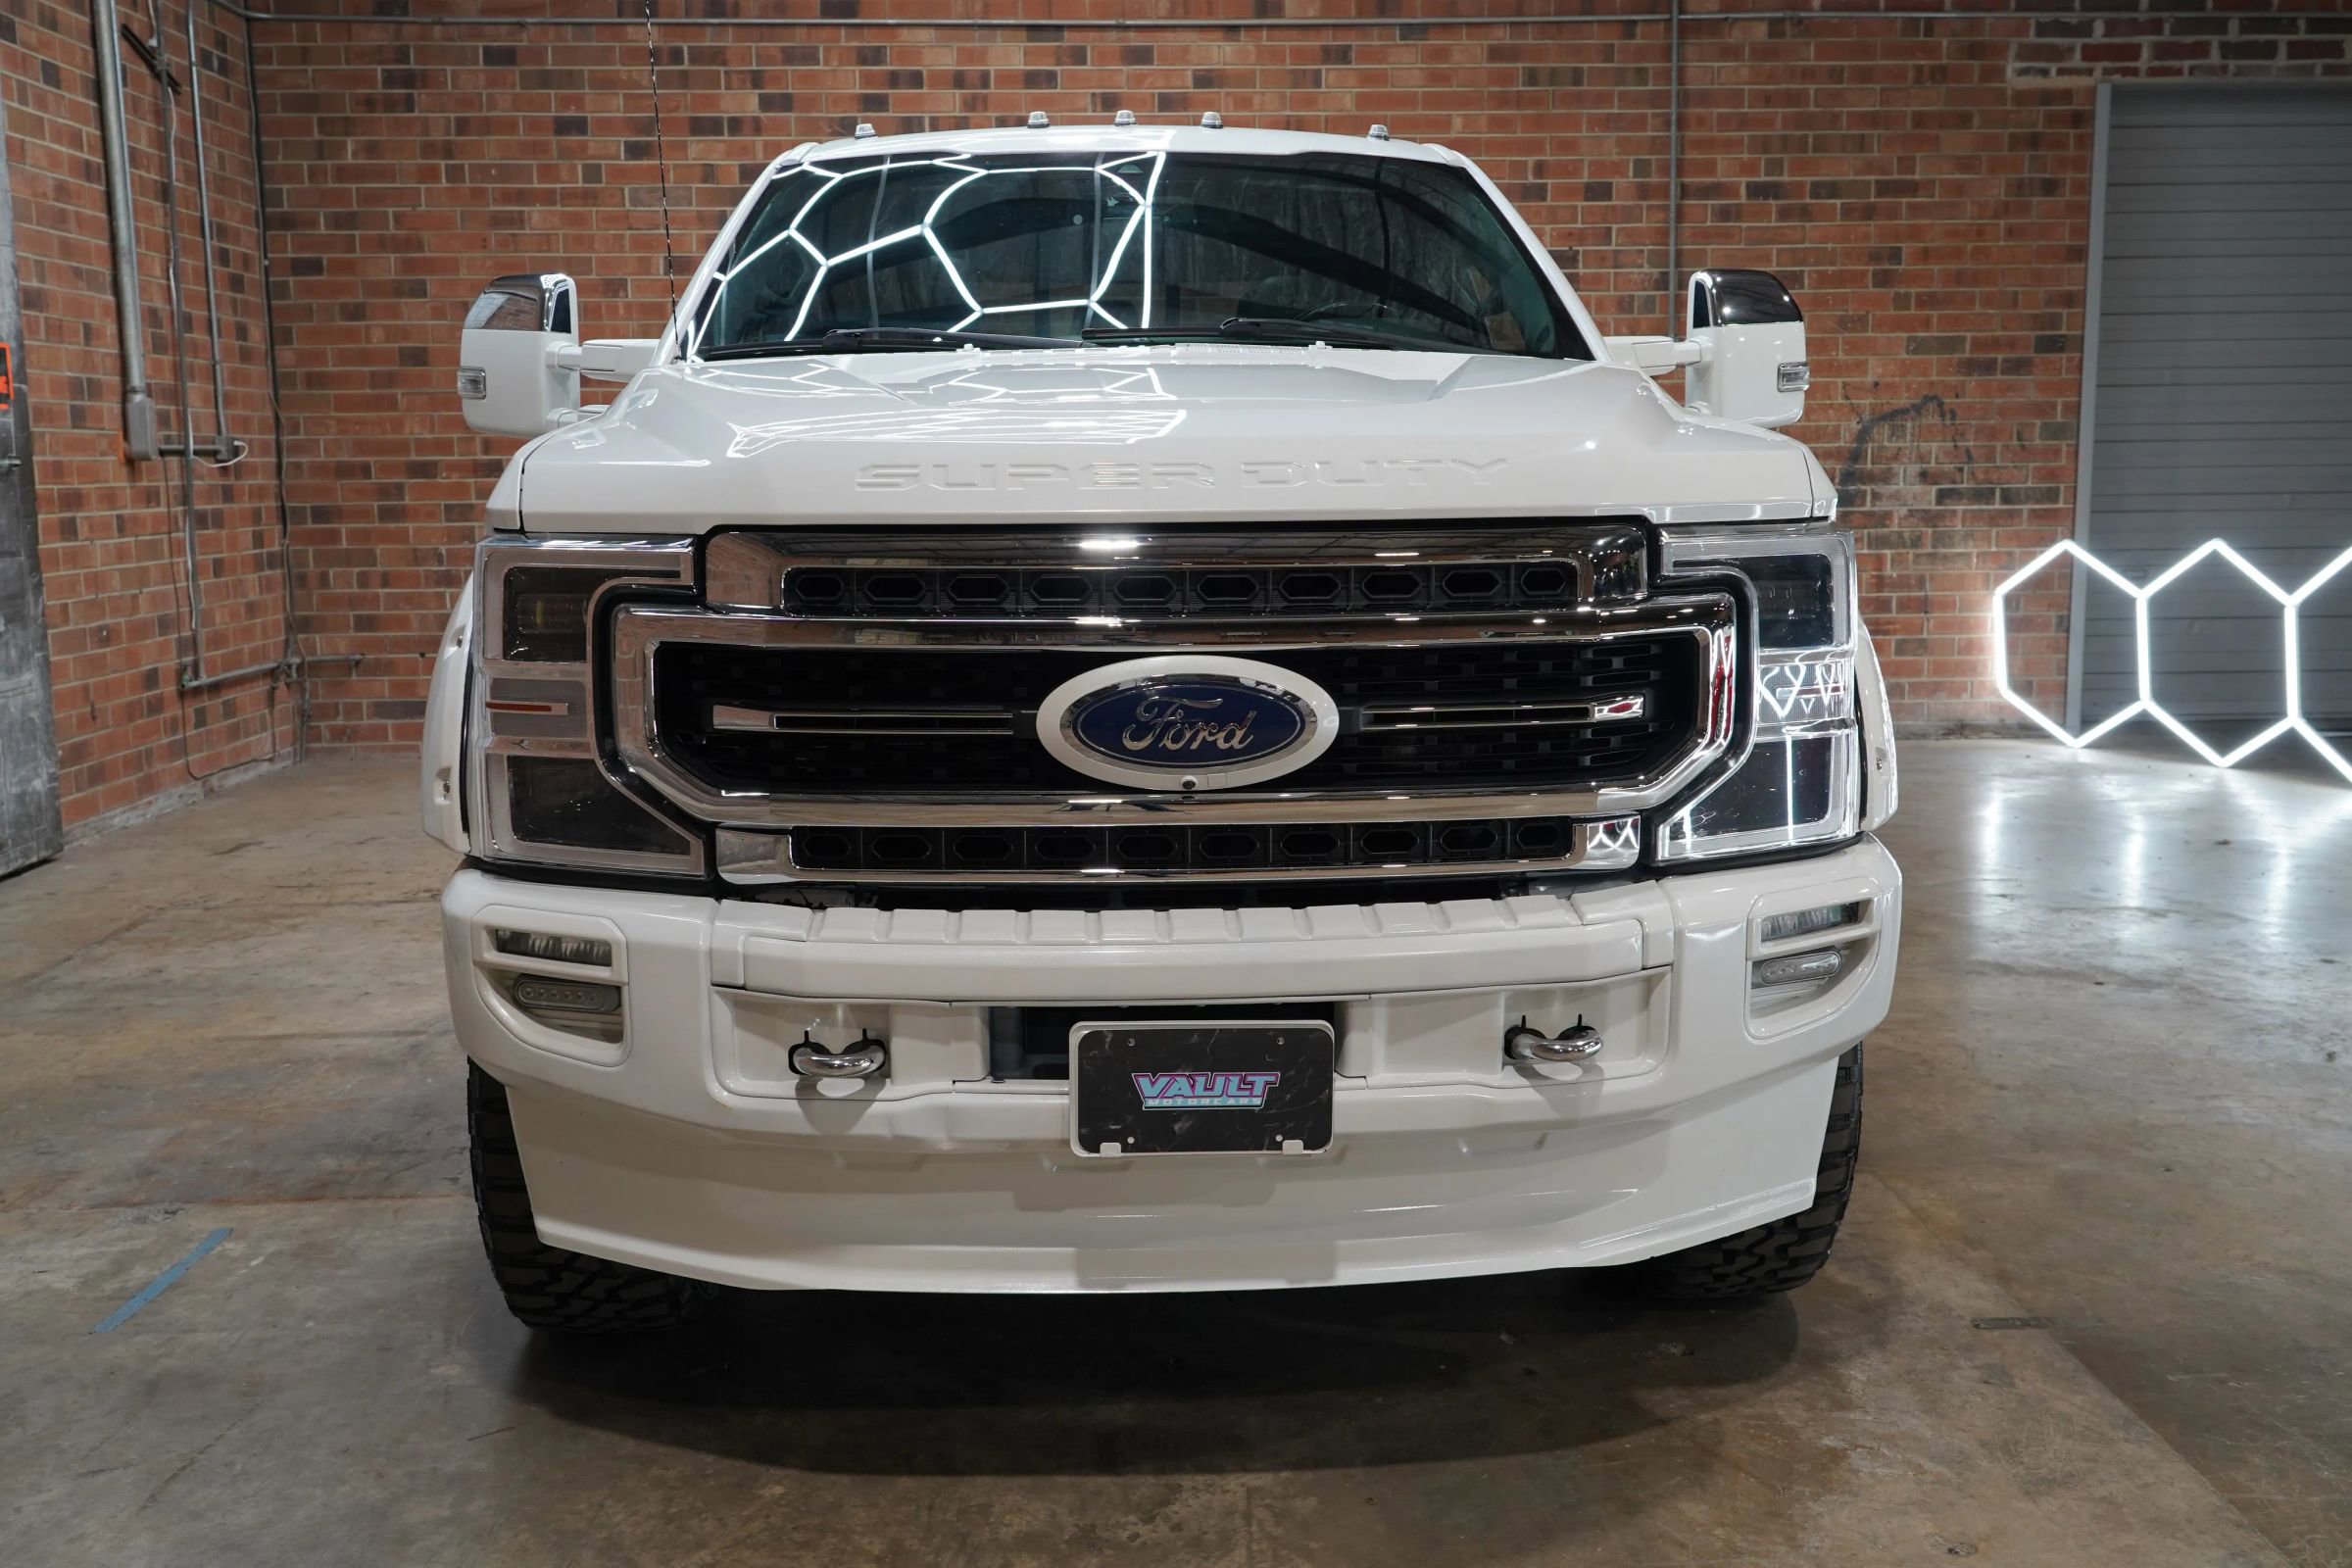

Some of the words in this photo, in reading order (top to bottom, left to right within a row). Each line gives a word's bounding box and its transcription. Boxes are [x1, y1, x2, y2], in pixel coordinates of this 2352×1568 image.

[855, 463, 1215, 491] SUPER
[1240, 458, 1509, 489] DUTY
[1121, 695, 1258, 752] Ford
[1133, 1073, 1279, 1098] VAULT
[1147, 1097, 1263, 1106] MOTORCARS
